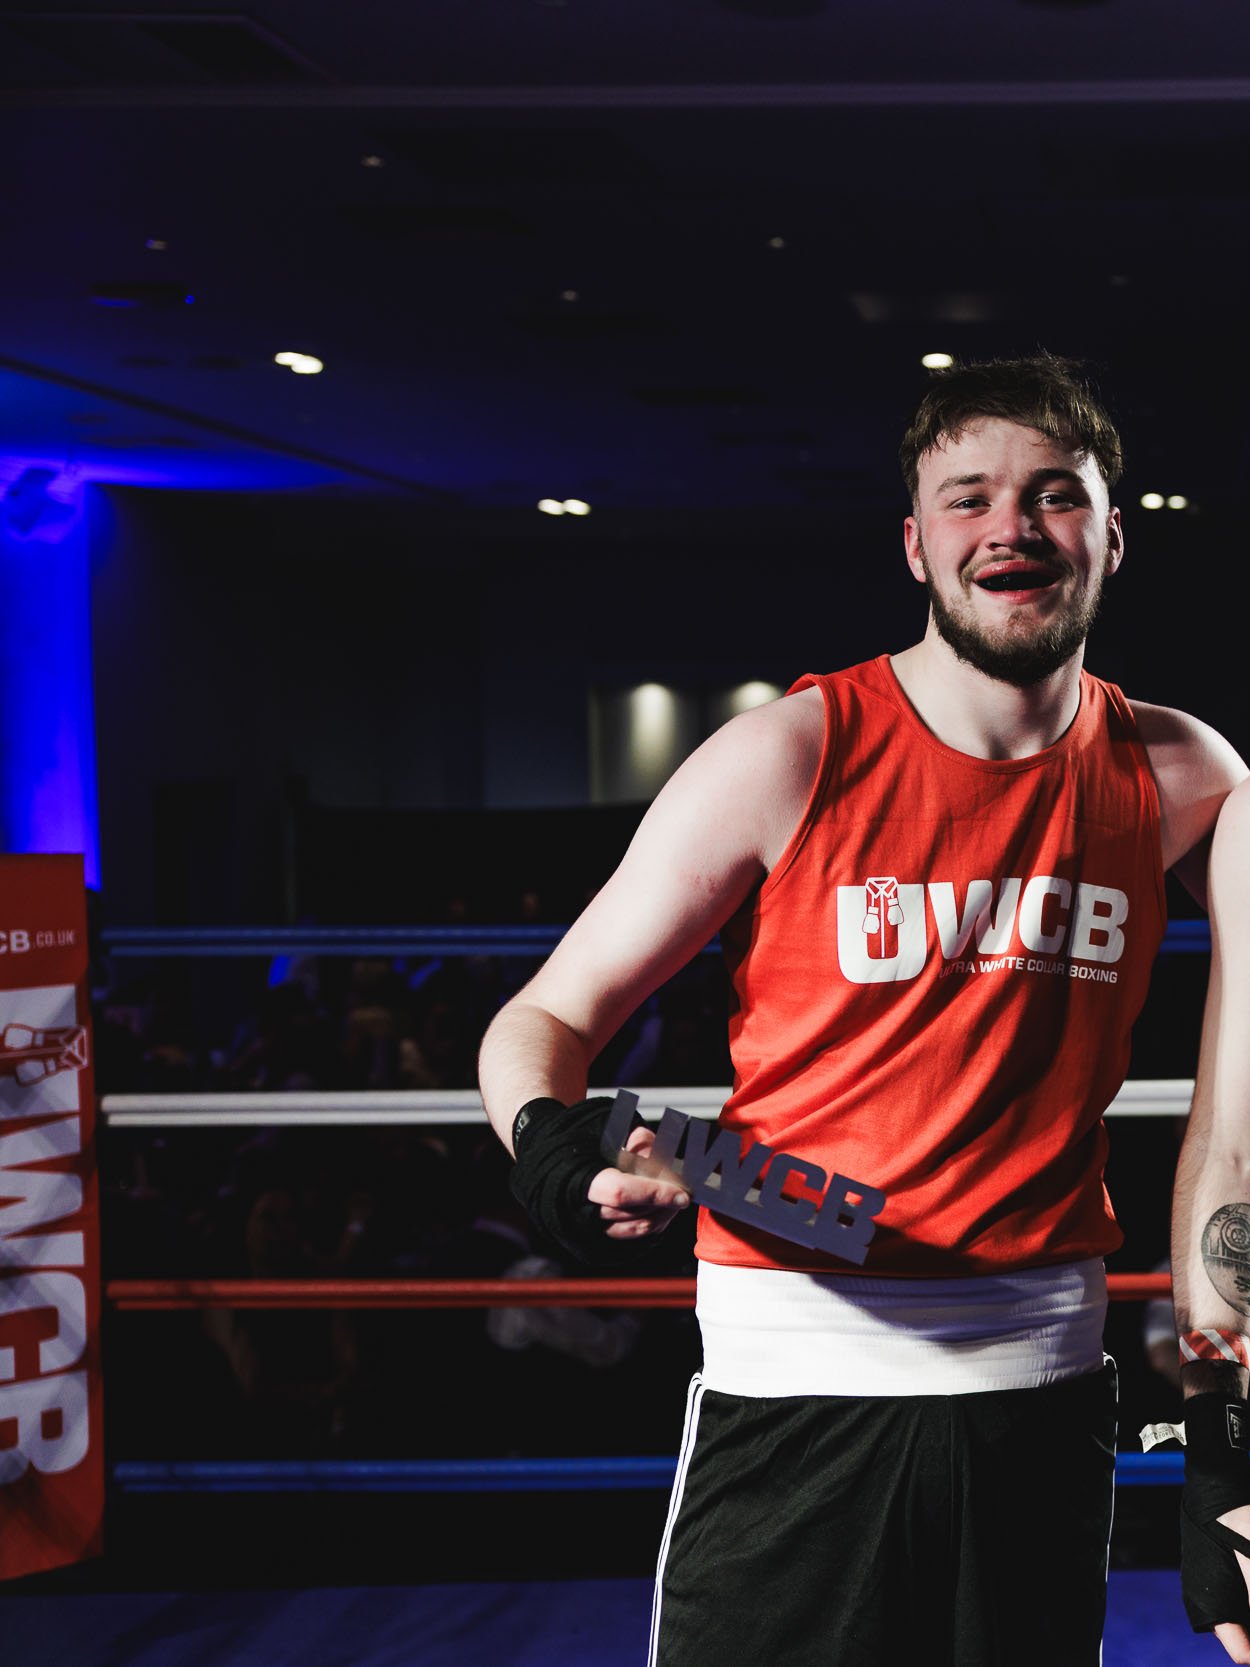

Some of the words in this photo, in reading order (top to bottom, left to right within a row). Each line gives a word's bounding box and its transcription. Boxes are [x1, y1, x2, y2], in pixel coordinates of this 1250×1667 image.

[837, 876, 1129, 984] UWCB
[939, 961, 976, 979] ULTRA
[979, 957, 1025, 973] WHITE
[1069, 965, 1118, 984] BOXING
